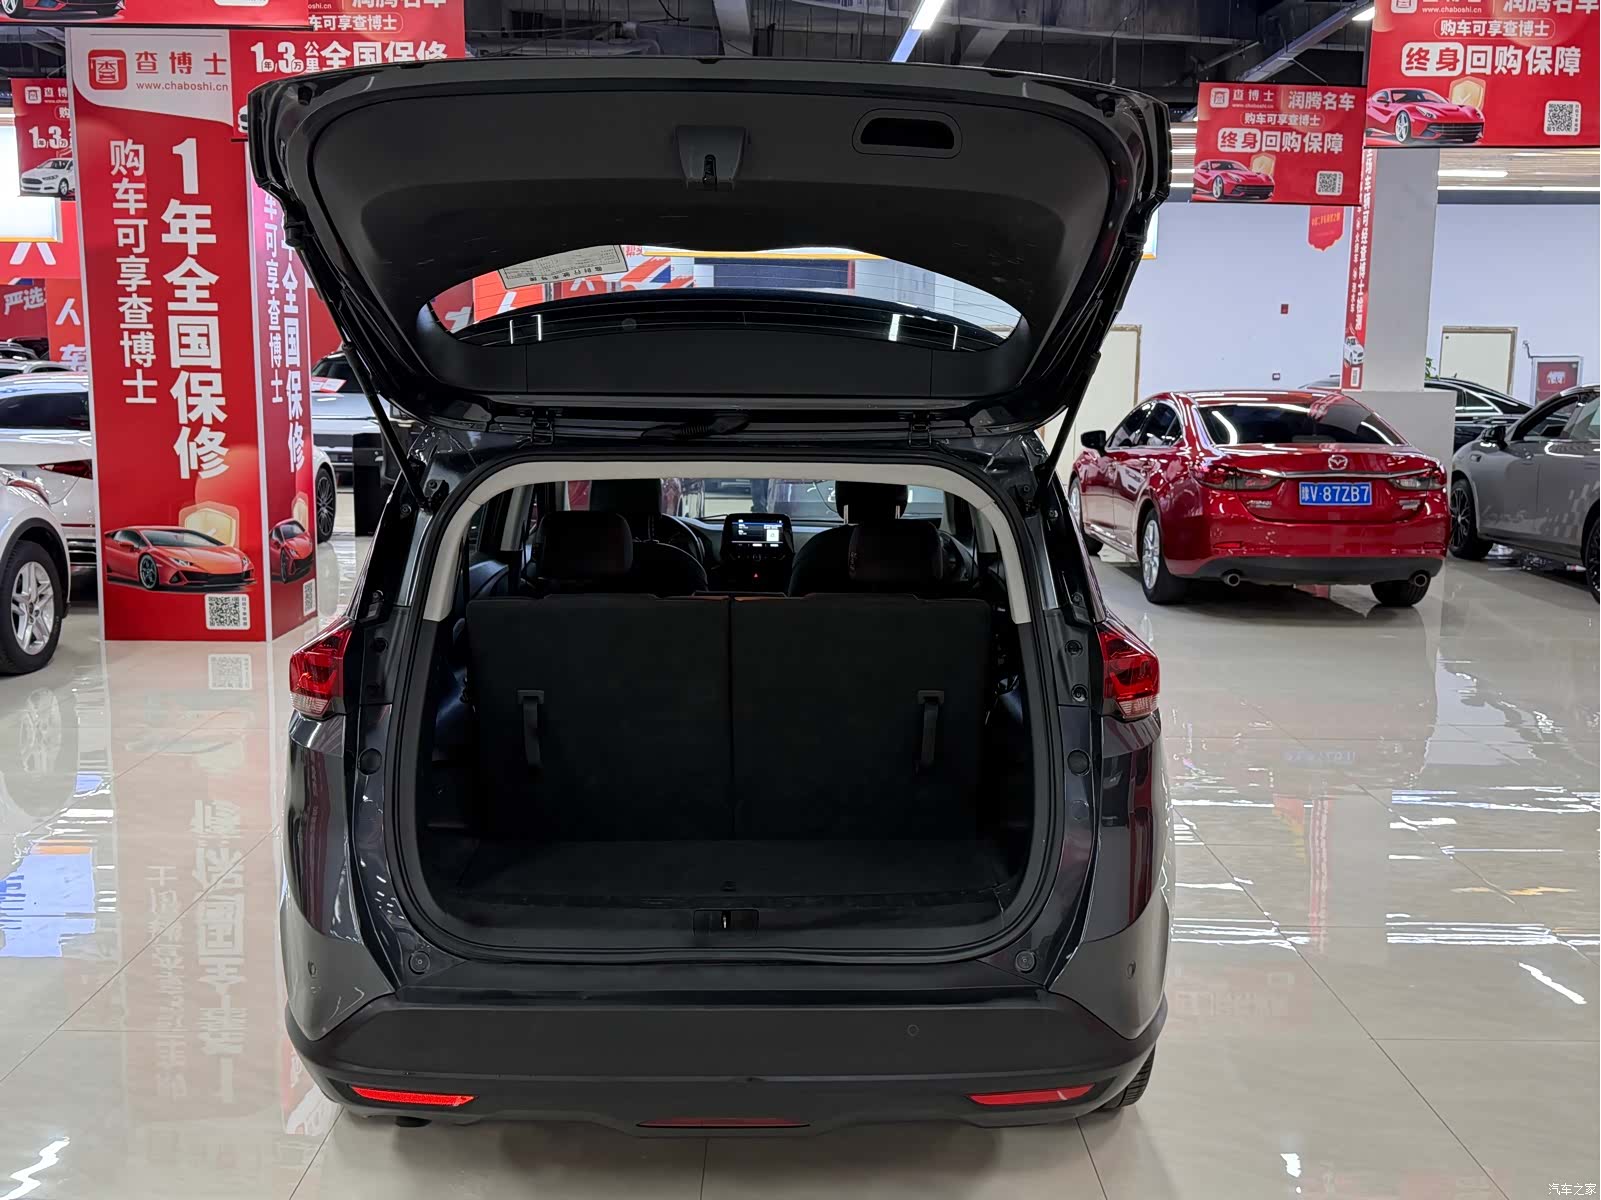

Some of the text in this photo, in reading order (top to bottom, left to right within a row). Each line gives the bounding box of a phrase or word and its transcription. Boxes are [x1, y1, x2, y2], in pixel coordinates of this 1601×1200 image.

[1422, 6, 1482, 14] www.chaboshi.cn
[308, 14, 398, 32] 车可享查博士
[1440, 19, 1550, 37] 购车可享查博士
[135, 51, 227, 75] 查博士
[1404, 44, 1582, 77] 终身回购保障
[136, 81, 228, 91] www.chaboshi.cn
[1232, 88, 1274, 102] 查博士
[1288, 90, 1356, 111] 润腾名车
[1244, 113, 1321, 126] 购车可享查博士
[1220, 131, 1344, 154] 终身回购保障
[109, 138, 158, 404] 购车可享查博士
[4, 286, 47, 316] 严选
[160, 137, 230, 480] 1年全国保修
[263, 191, 284, 404] 车可享查博士
